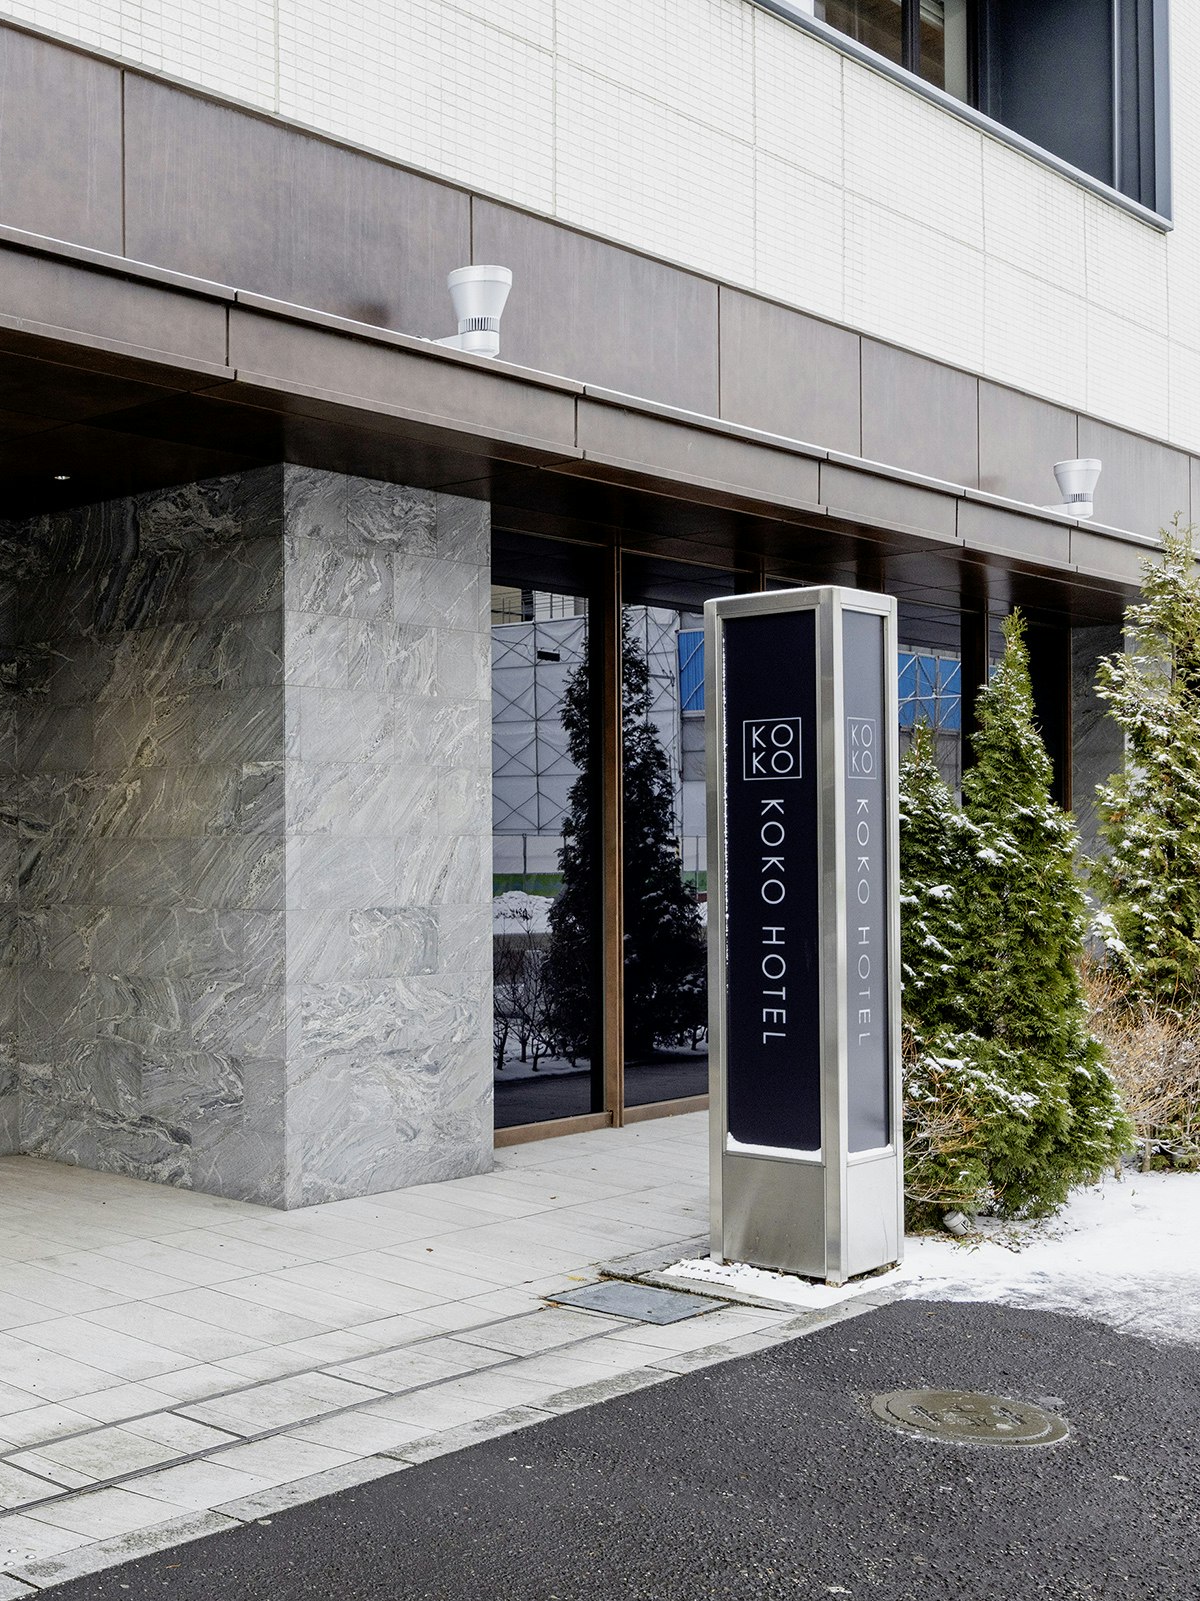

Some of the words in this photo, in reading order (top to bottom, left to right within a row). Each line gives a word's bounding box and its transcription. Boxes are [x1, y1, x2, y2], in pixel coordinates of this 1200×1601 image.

[752, 723, 794, 748] KO
[752, 750, 794, 774] KO
[851, 724, 873, 748] KO
[851, 750, 873, 774] KO
[760, 799, 786, 905] KOKO
[856, 799, 870, 905] KOKO
[761, 926, 787, 1045] HOTEL
[857, 926, 871, 1046] HOTEL
